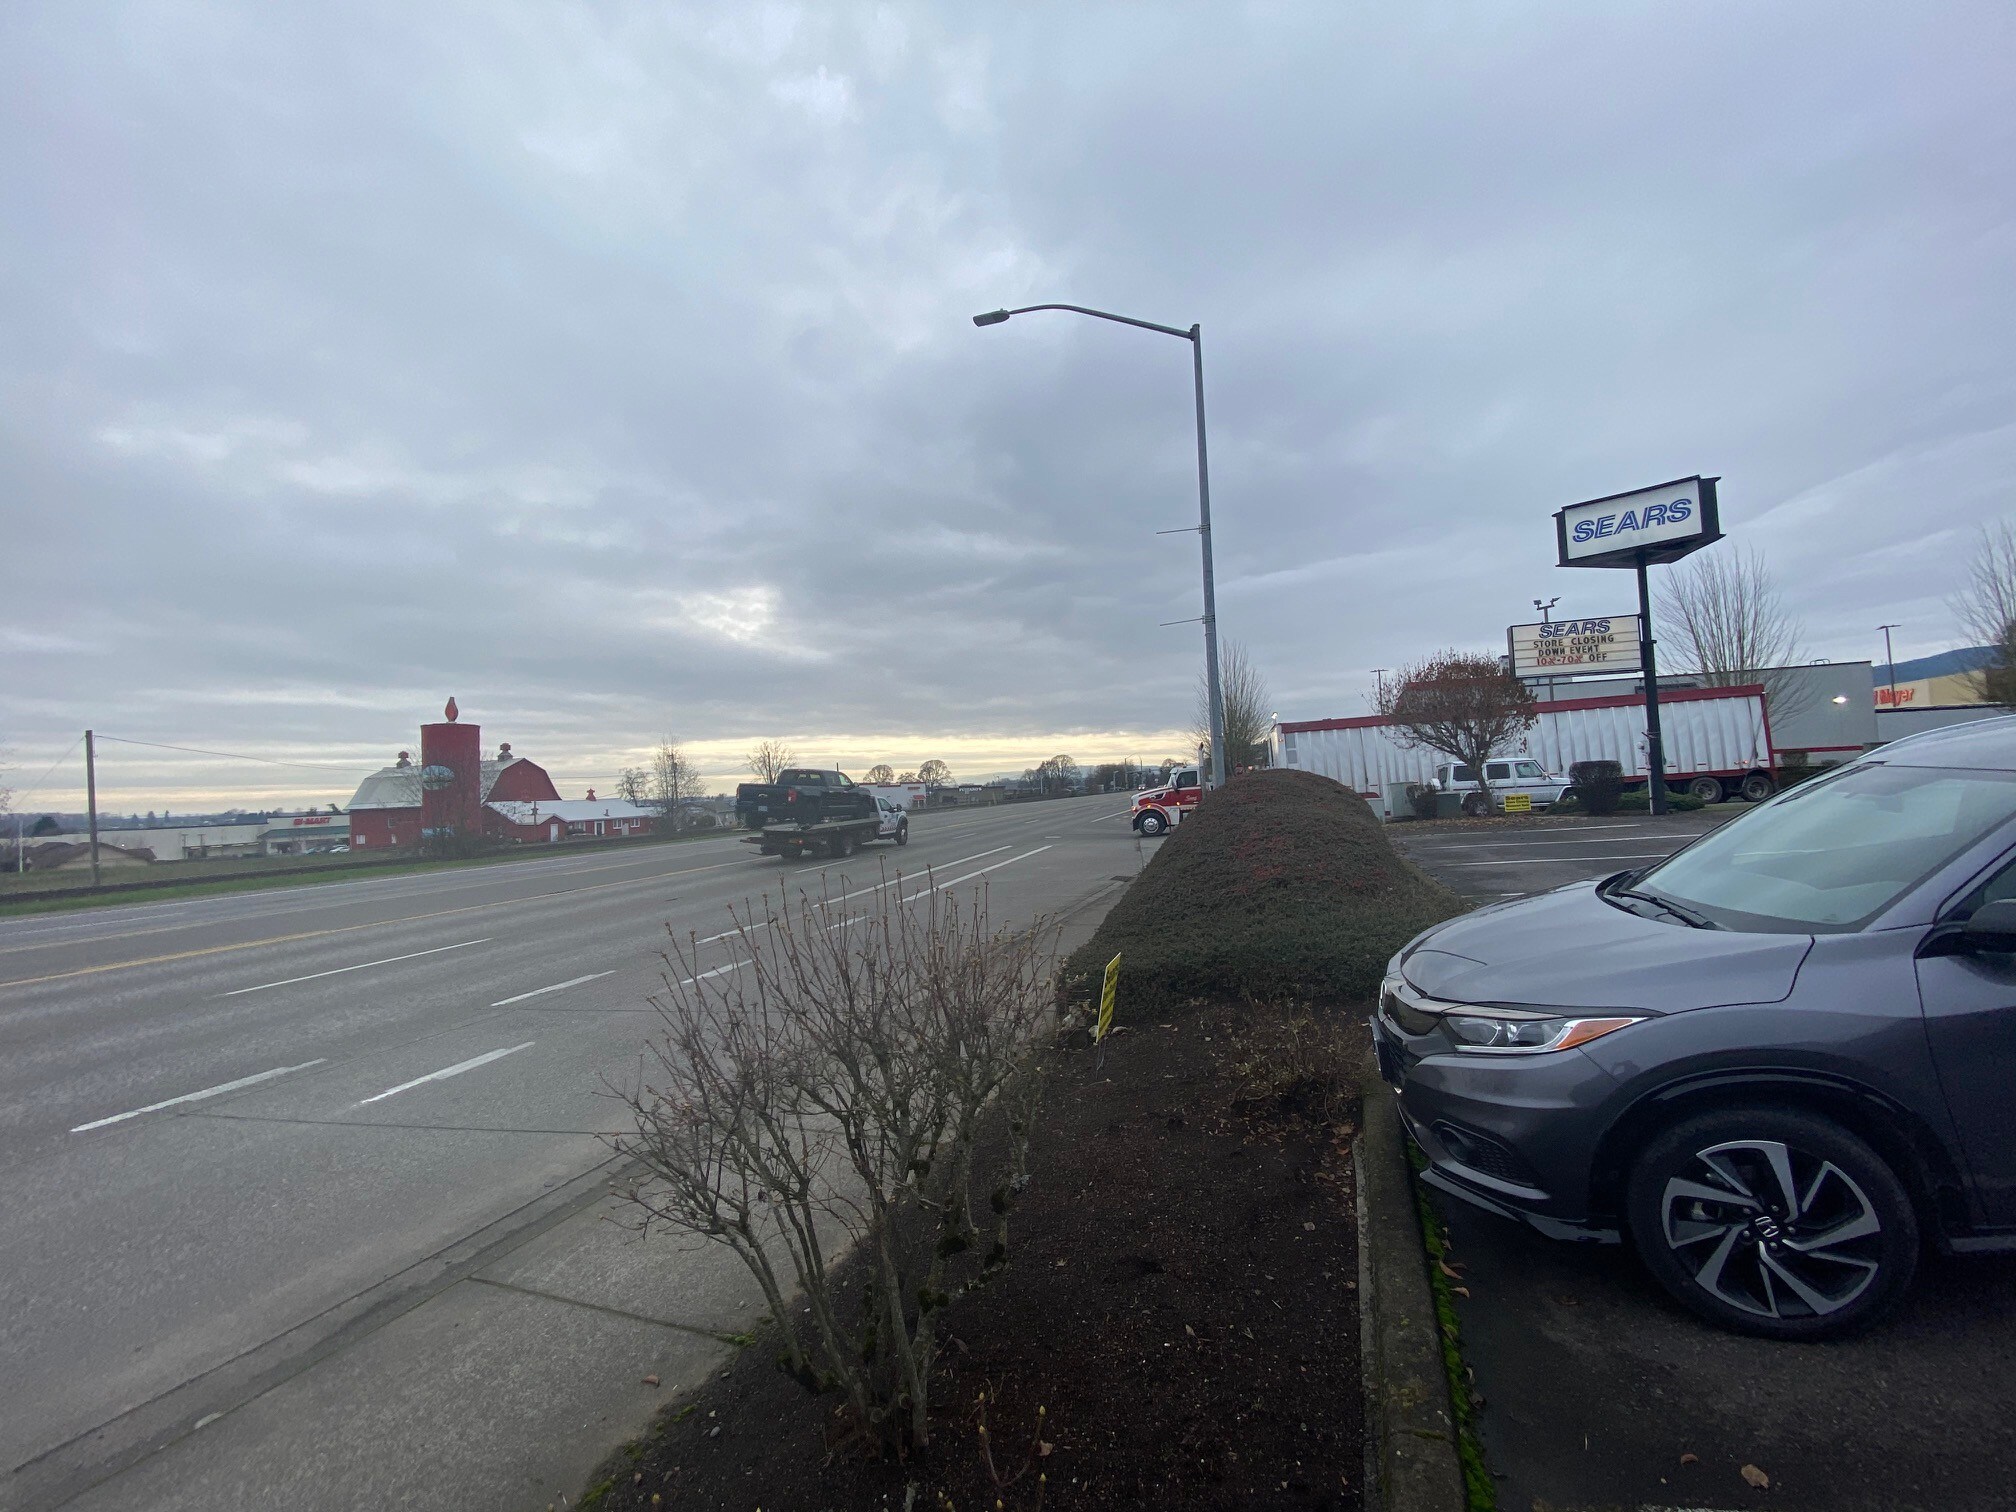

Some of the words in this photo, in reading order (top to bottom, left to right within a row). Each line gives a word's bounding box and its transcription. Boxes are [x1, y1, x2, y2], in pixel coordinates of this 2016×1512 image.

[1572, 498, 1692, 543] SEARS
[1539, 620, 1611, 638] SEARS
[1533, 639, 1563, 649] STORE
[1571, 634, 1614, 646] CLOSING
[1539, 647, 1566, 657] DOWN
[1570, 645, 1599, 655] EVENT
[1536, 653, 1583, 666] 10%-70%
[1589, 653, 1608, 662] OFF
